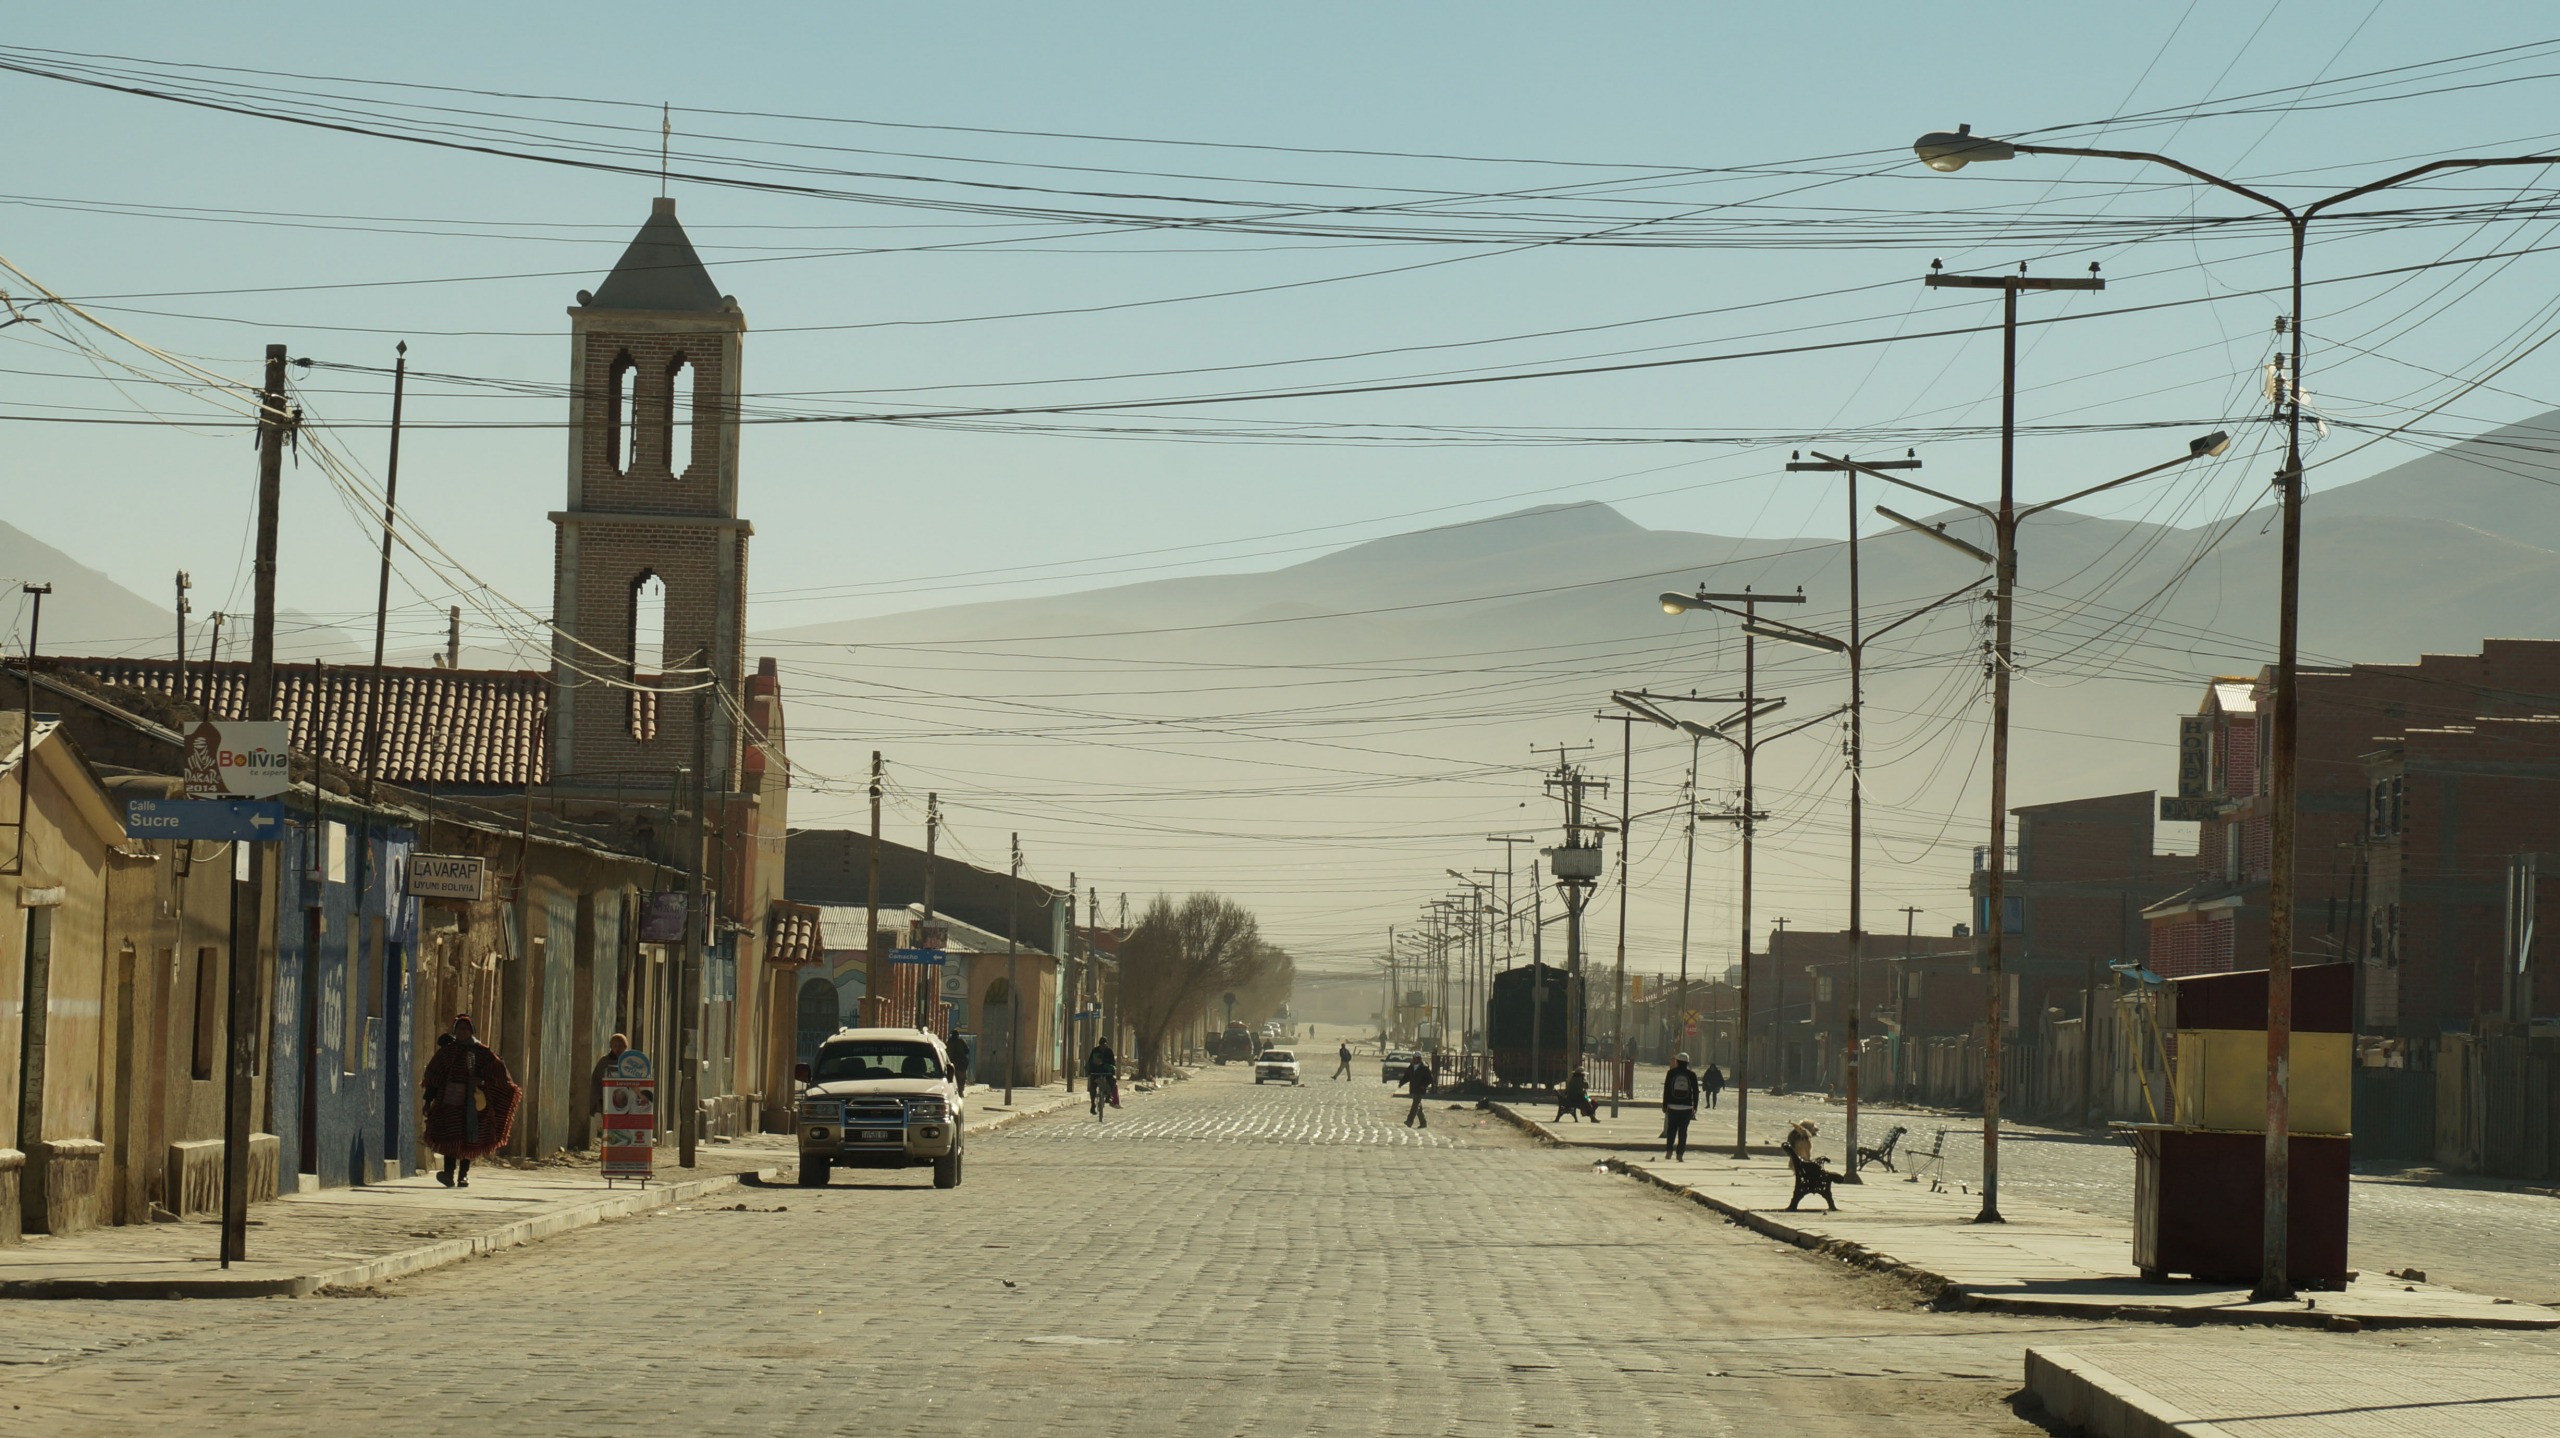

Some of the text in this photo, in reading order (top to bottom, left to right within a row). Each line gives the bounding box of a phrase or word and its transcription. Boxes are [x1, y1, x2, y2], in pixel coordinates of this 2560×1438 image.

[220, 749, 288, 768] Bolivia
[184, 768, 219, 783] DAKAR
[186, 784, 218, 792] 2014
[129, 800, 156, 811] Calle
[130, 813, 180, 827] Sucre
[414, 860, 478, 879] LAVARAP
[414, 881, 474, 892] UYUNI BOLIVIA
